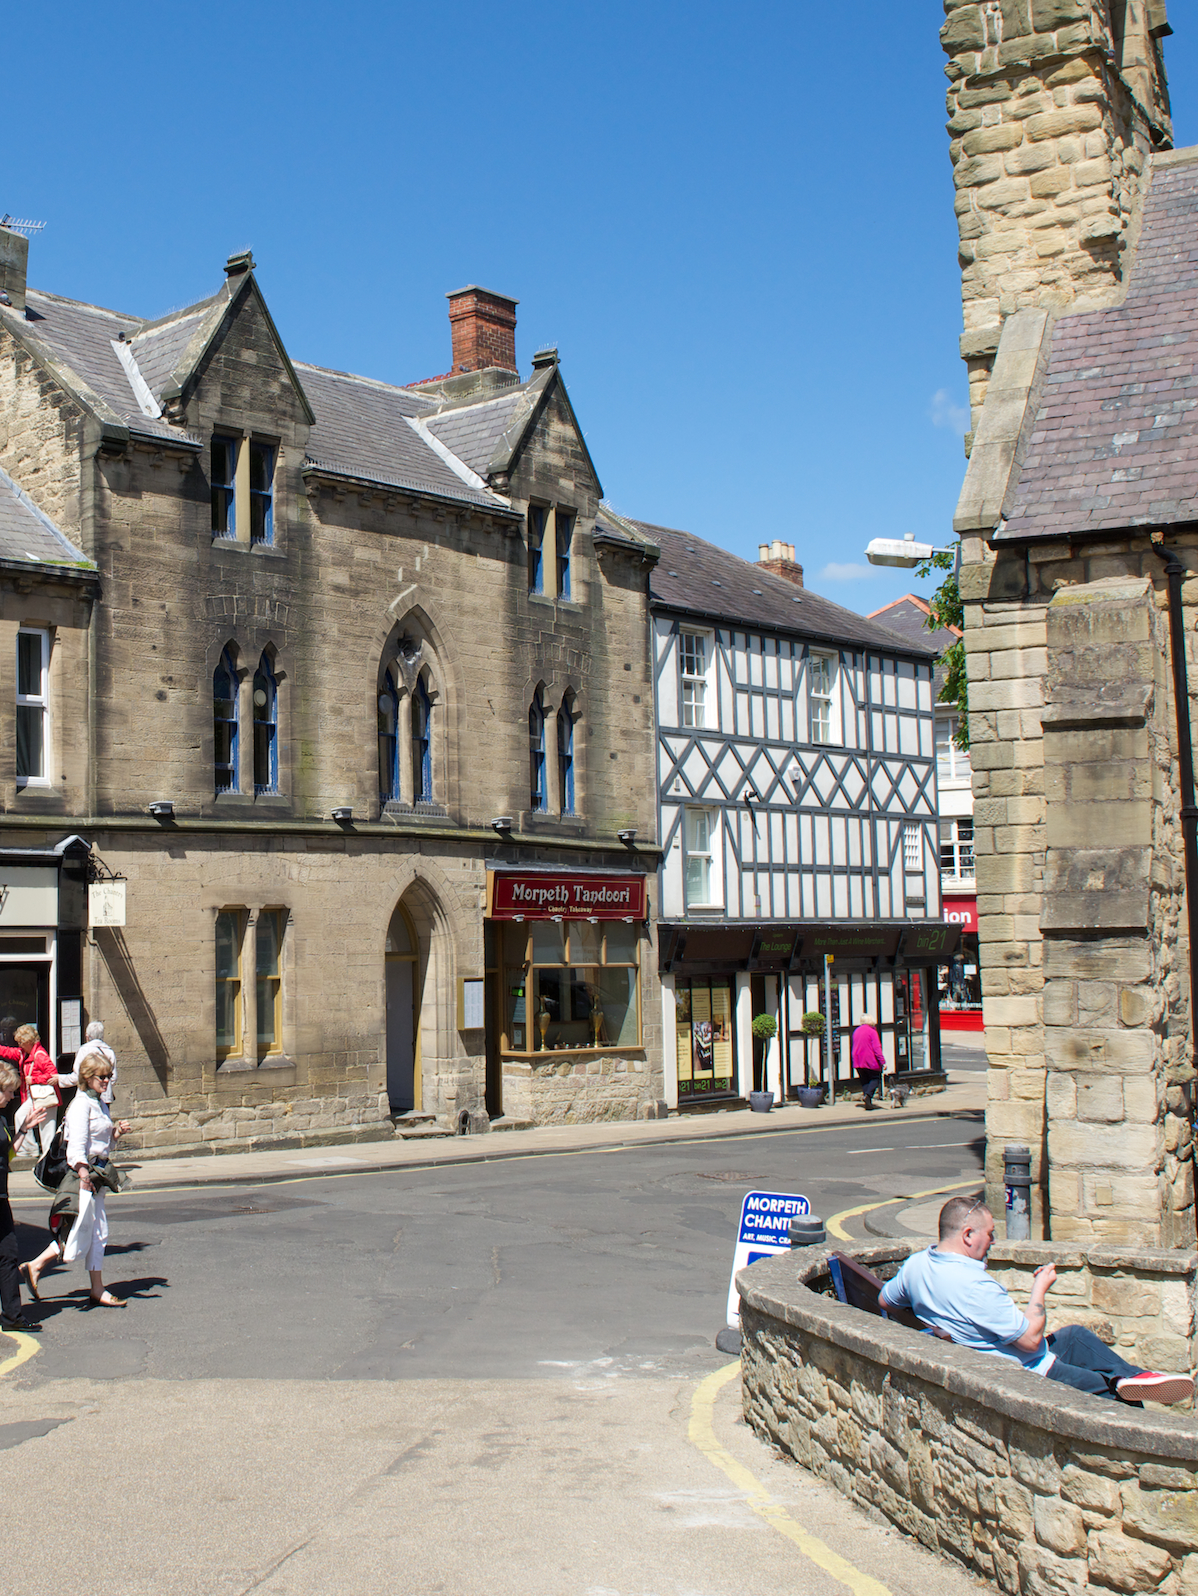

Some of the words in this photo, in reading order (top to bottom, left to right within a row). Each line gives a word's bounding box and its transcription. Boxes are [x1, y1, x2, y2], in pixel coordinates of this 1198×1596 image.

[512, 883, 569, 905] Morpeth
[573, 885, 630, 905] Tandoori
[943, 908, 971, 924] ion
[771, 942, 792, 953] Lounge
[747, 1197, 806, 1215] MORPETH
[756, 1234, 778, 1244] MUSIC,
[778, 1236, 792, 1245] CRA
